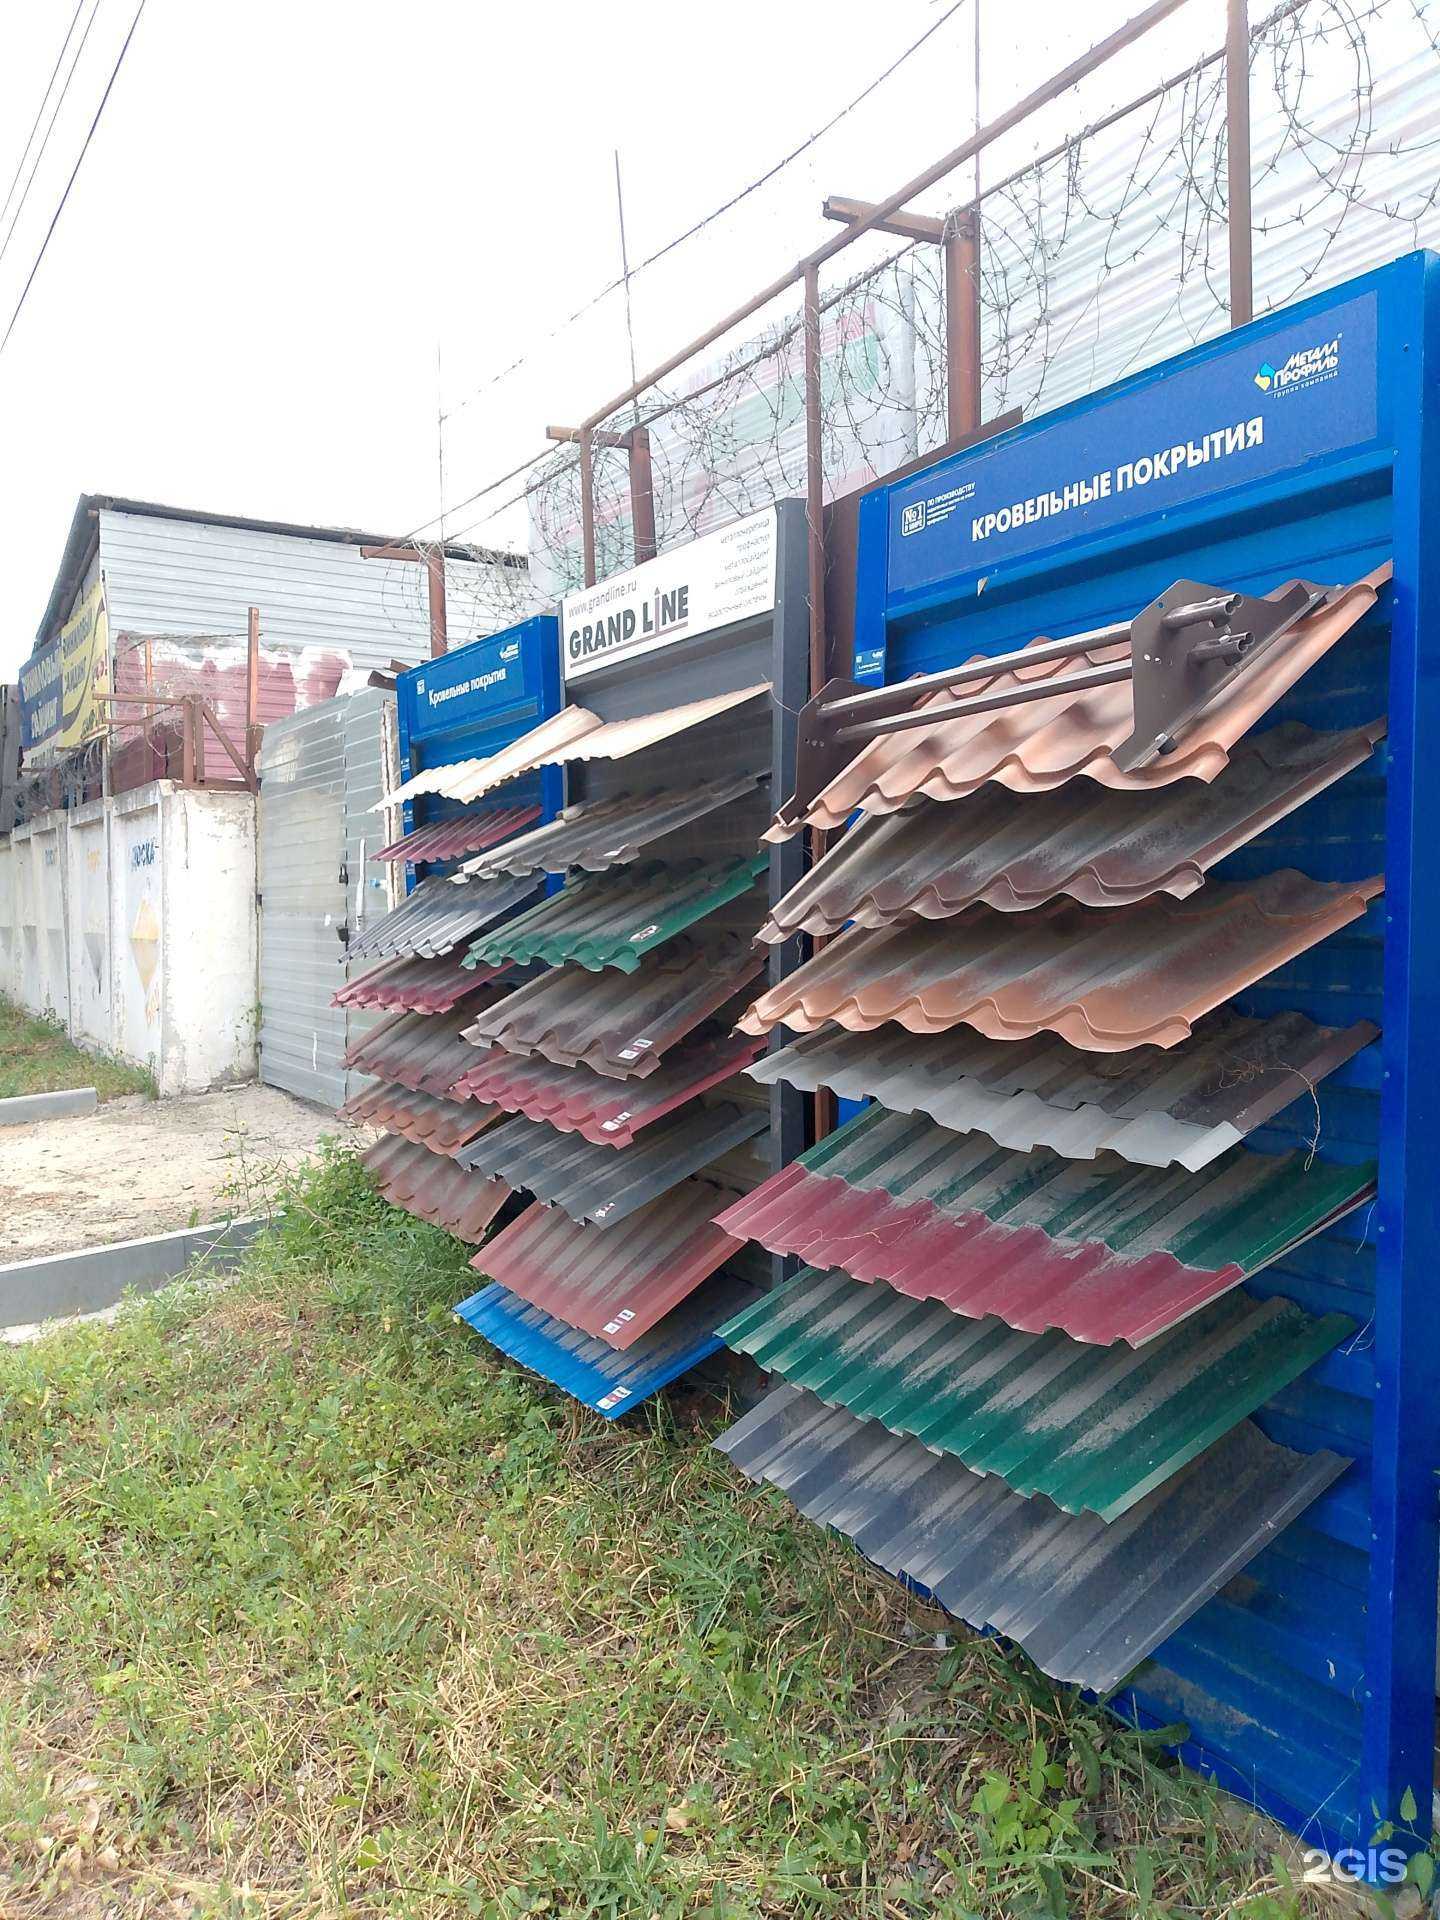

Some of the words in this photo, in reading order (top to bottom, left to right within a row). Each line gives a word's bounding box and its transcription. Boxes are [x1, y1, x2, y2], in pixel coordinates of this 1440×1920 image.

[1273, 356, 1339, 389] ПРОФИЛЬ
[1283, 340, 1339, 372] МЕТАЛЛ
[971, 471, 1112, 542] КРОВЕЛЬНЫЕ
[1116, 416, 1264, 493] ПОКРЫТИЯ
[568, 580, 637, 618] www.grandline.ru
[569, 608, 636, 659] GRAND
[642, 584, 689, 633] LINE
[428, 681, 470, 708] Кровельные
[470, 667, 507, 692] покрытия
